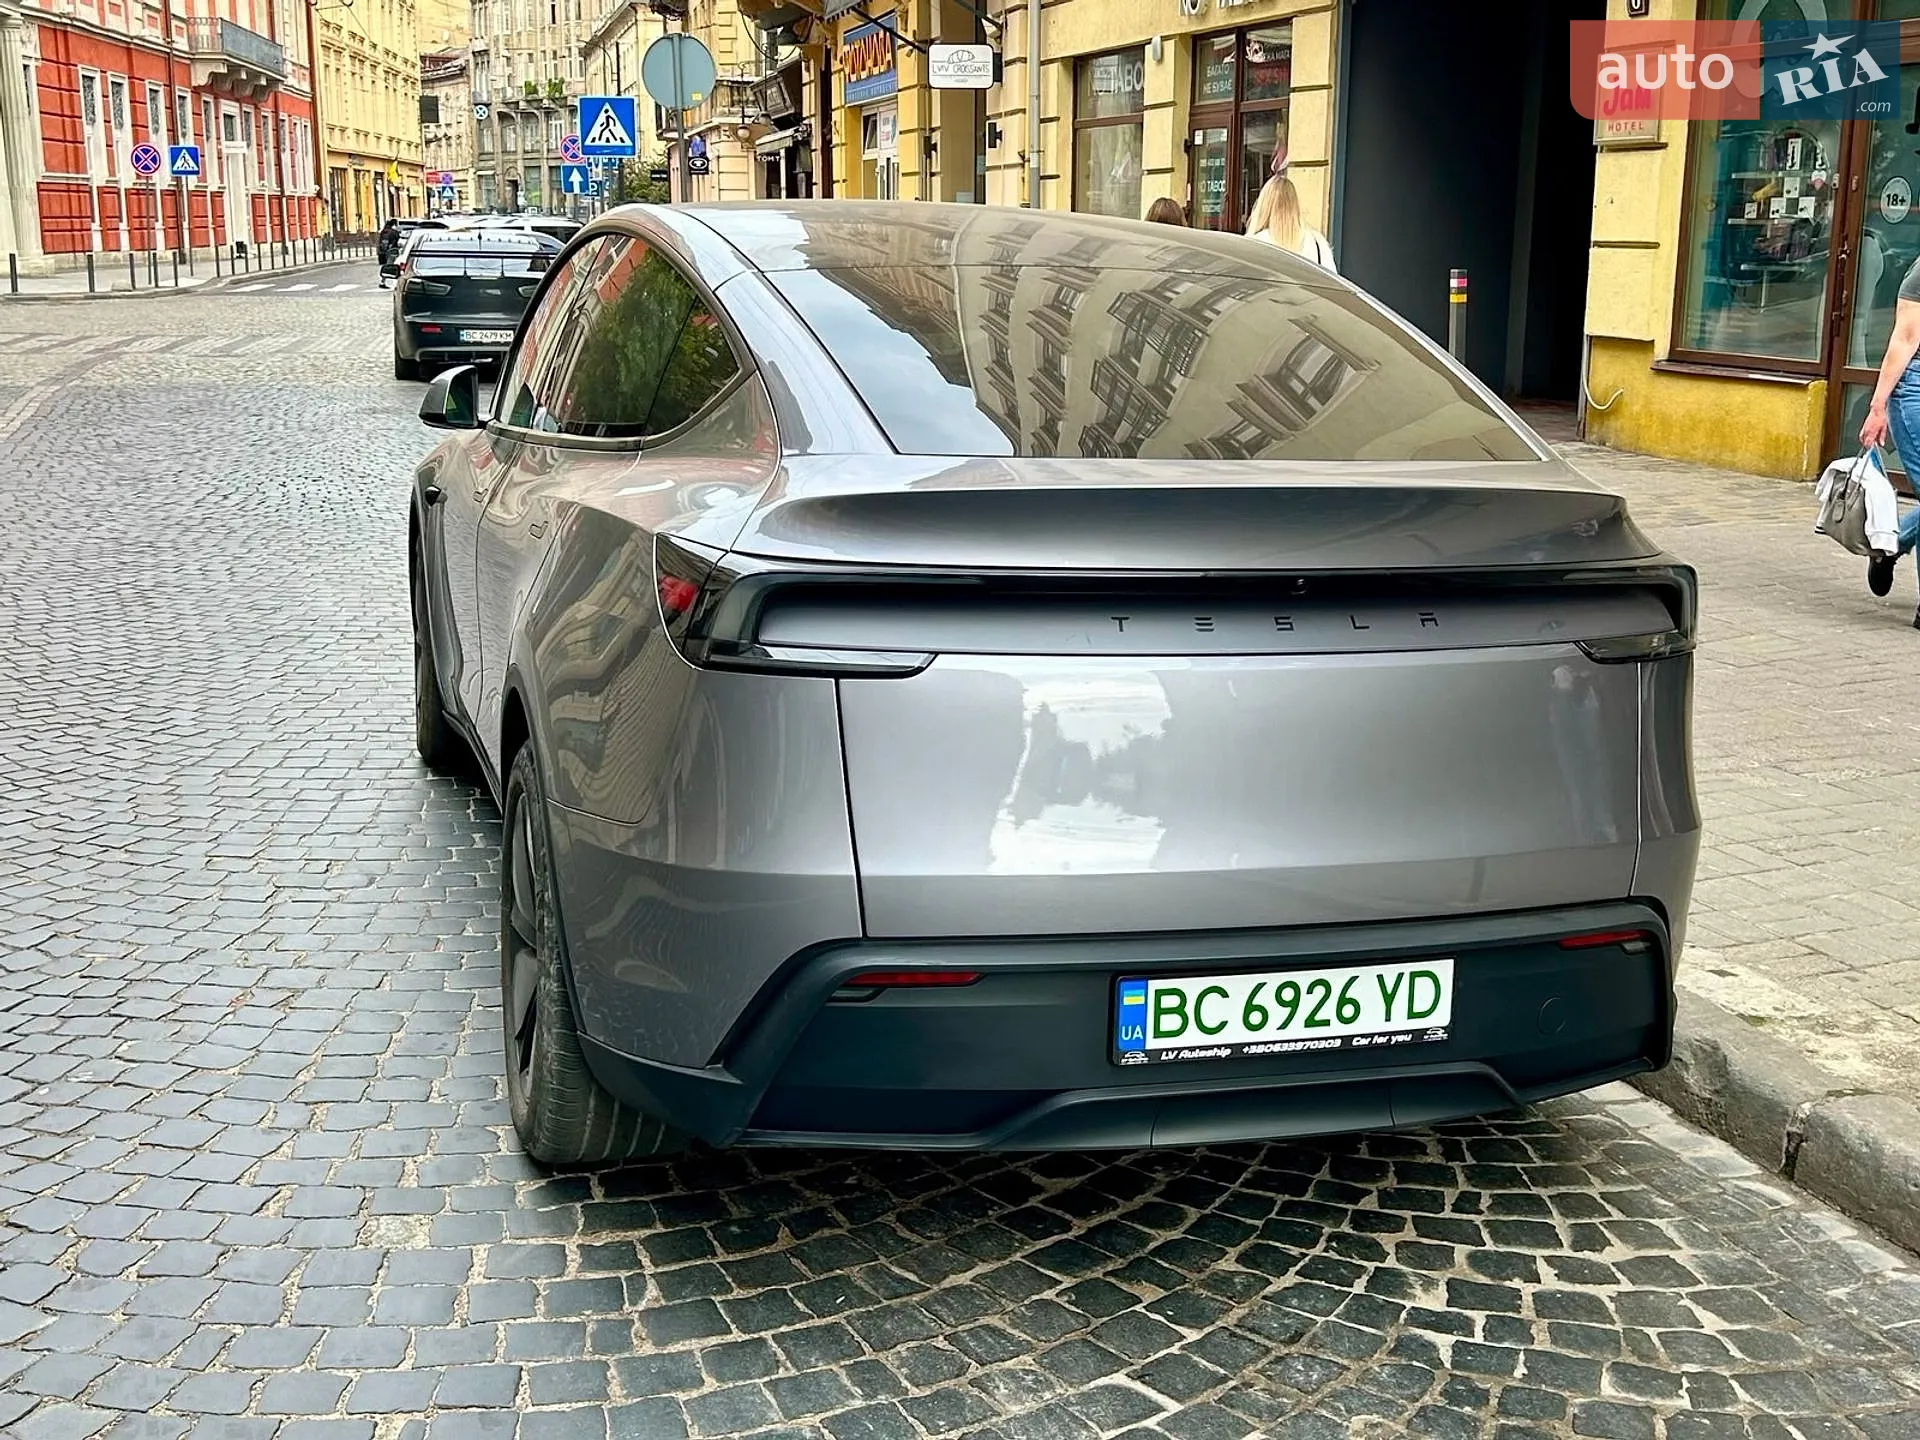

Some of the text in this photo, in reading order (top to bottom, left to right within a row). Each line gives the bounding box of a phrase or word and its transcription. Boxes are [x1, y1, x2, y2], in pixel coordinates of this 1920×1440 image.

[1607, 121, 1645, 132] HOTEL
[1886, 193, 1906, 207] 18+
[465, 331, 478, 340] BC
[479, 331, 498, 340] 2479
[1111, 612, 1439, 632] TESLA
[1153, 970, 1442, 1039] BC 6926 YD
[1121, 1025, 1144, 1040] UA
[1160, 1051, 1179, 1061] LV
[1178, 1047, 1232, 1059] Autoship
[1352, 1036, 1372, 1046] Car
[1371, 1035, 1390, 1044] for
[1390, 1033, 1412, 1045] you
